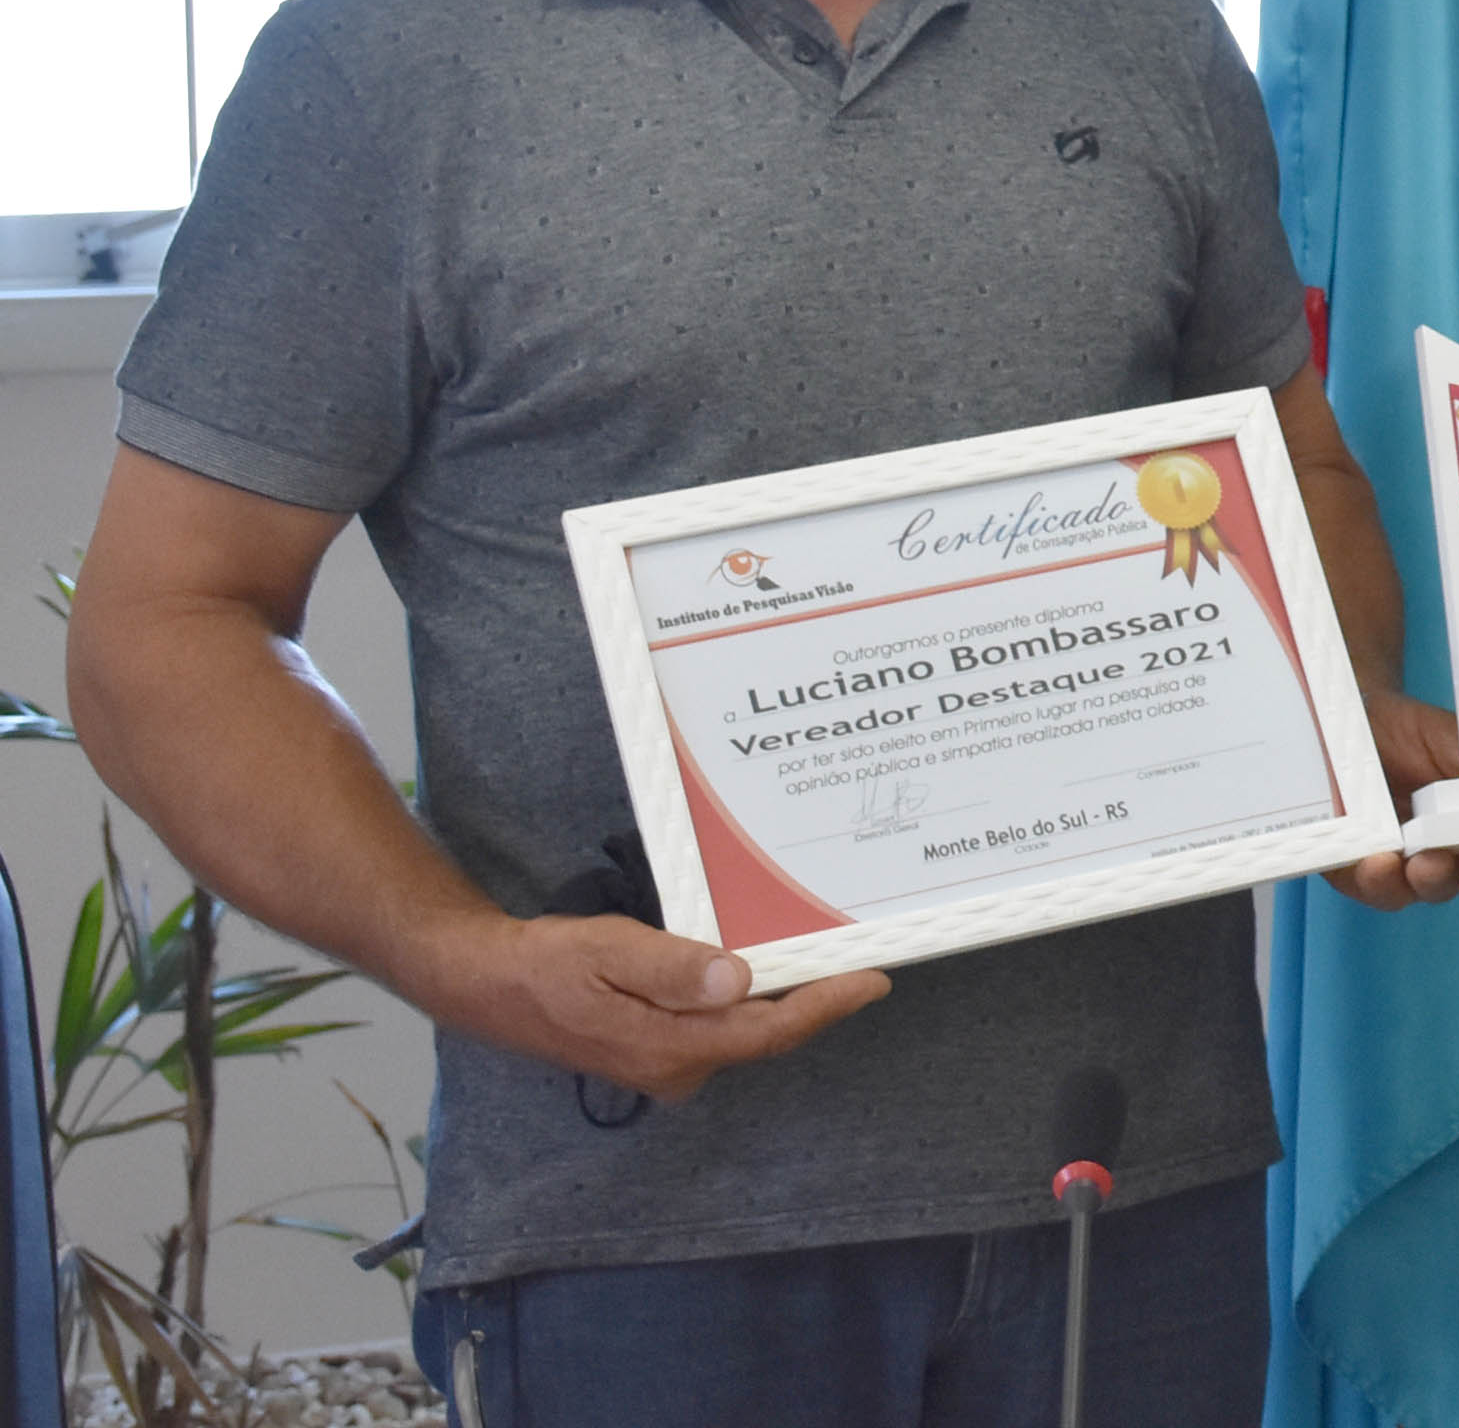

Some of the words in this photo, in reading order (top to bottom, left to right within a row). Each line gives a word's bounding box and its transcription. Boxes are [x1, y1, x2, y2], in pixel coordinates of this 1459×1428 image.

[888, 481, 1132, 561] Certificado
[1015, 542, 1029, 555] de
[1032, 528, 1105, 553] Consagração
[1107, 519, 1148, 538] Pública
[657, 608, 720, 629] Instituto
[723, 602, 741, 617] de
[743, 589, 815, 612] Pesquisas
[815, 581, 854, 599] Visão
[833, 633, 938, 665] Outorgamos
[943, 631, 954, 642] o
[959, 614, 1031, 641] presente
[1035, 600, 1104, 625] diploma
[723, 711, 736, 723] a
[748, 660, 935, 715] Luciano
[950, 602, 1220, 672] Bombassaro
[730, 705, 922, 756] Vereador
[938, 663, 1125, 714] Destaque
[1140, 636, 1233, 673] 2021
[778, 758, 806, 778] por
[813, 751, 834, 767] ter
[840, 743, 875, 761] sido
[879, 733, 926, 753] eleito
[930, 726, 960, 741] em
[964, 712, 1032, 735] Primeiro
[1036, 700, 1078, 724] lugar
[1082, 694, 1105, 711] na
[1109, 679, 1180, 707] pesquisa
[1184, 673, 1207, 688] de
[785, 769, 852, 796] opinião
[855, 754, 920, 782] pública
[925, 753, 936, 765] e
[941, 736, 1012, 762] simpatia
[1017, 718, 1094, 746] realizada
[1099, 707, 1142, 728] nesta
[1146, 696, 1210, 719] cidade.
[923, 839, 981, 862] Monte
[985, 826, 1027, 847] Belo
[1033, 819, 1055, 837] do
[1059, 809, 1088, 831] Sul
[1105, 800, 1129, 822] RS
